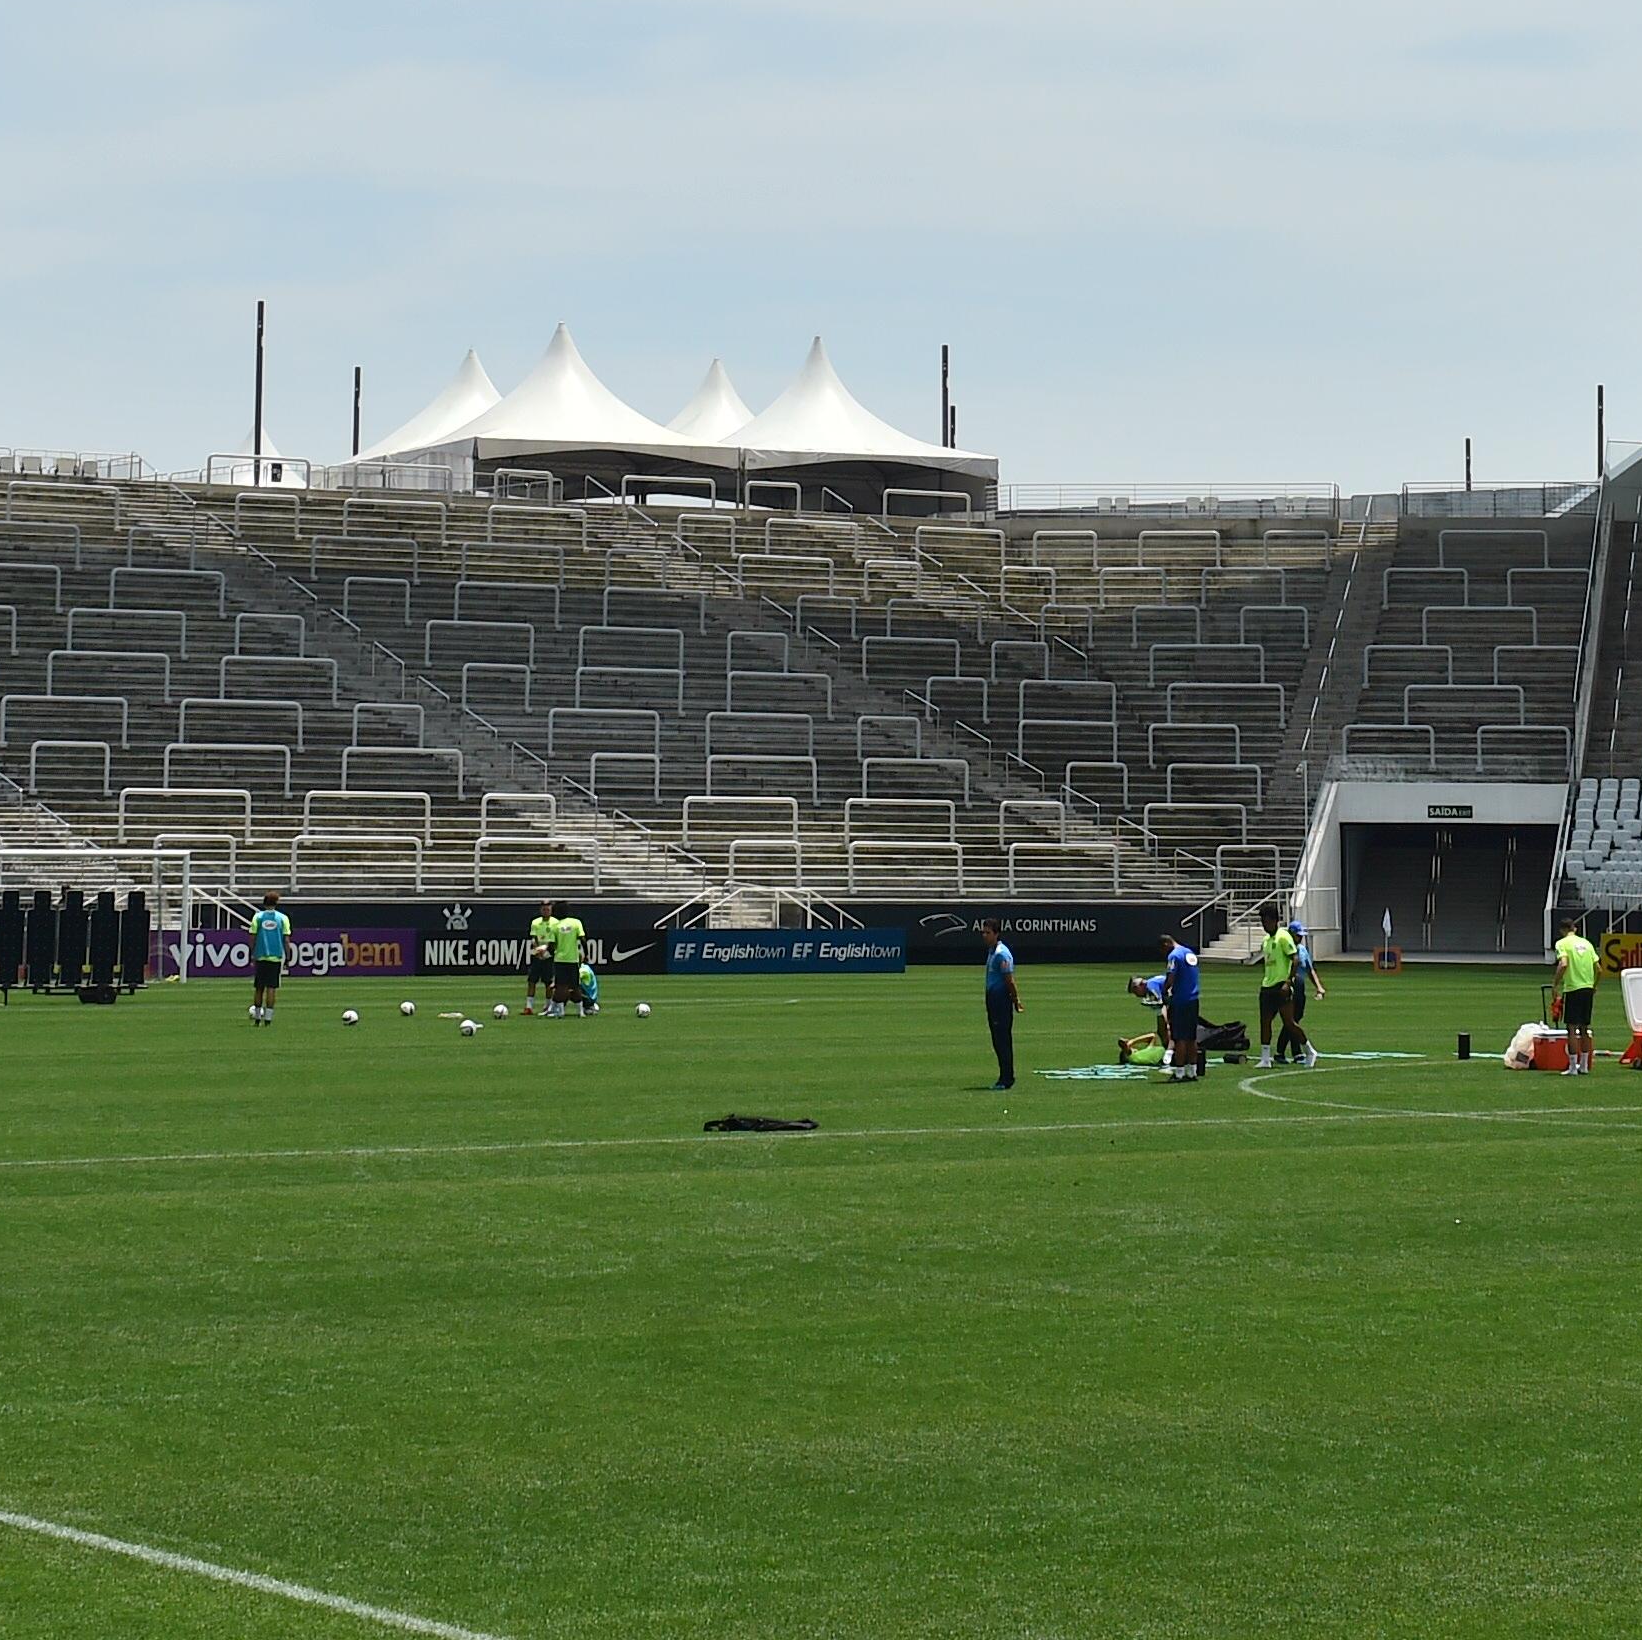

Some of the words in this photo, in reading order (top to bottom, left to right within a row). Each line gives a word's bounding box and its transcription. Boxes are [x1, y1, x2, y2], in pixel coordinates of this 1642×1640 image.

[1015, 918, 1097, 933] CORINTHIANS
[169, 933, 251, 968] vivo
[278, 933, 404, 976] pegabem
[673, 943, 697, 960] EF
[702, 942, 787, 963] Englishtown
[791, 942, 814, 960] EF
[819, 942, 902, 962] Englishtown
